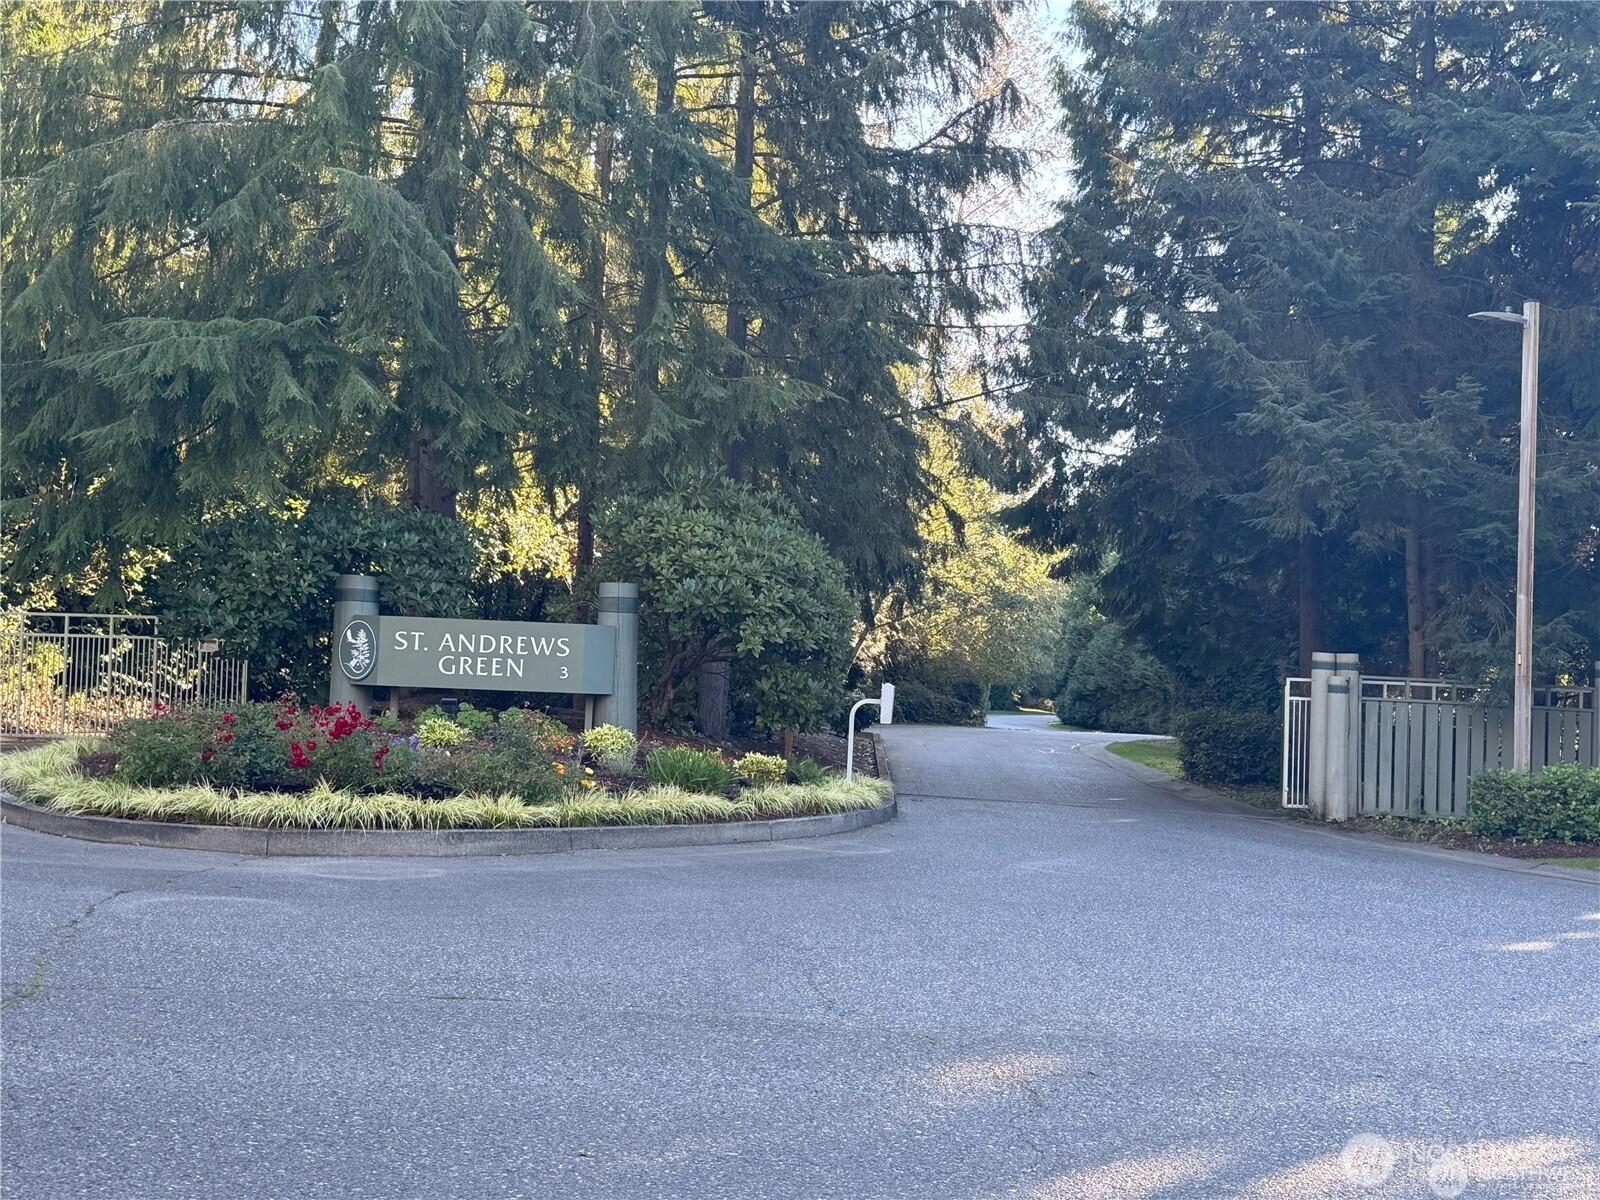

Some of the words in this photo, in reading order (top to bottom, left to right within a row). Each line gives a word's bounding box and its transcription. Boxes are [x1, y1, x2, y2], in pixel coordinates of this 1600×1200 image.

[393, 630, 428, 652] ST.
[438, 633, 570, 657] ANDREWS
[438, 655, 524, 678] GREEN
[559, 666, 569, 679] 3
